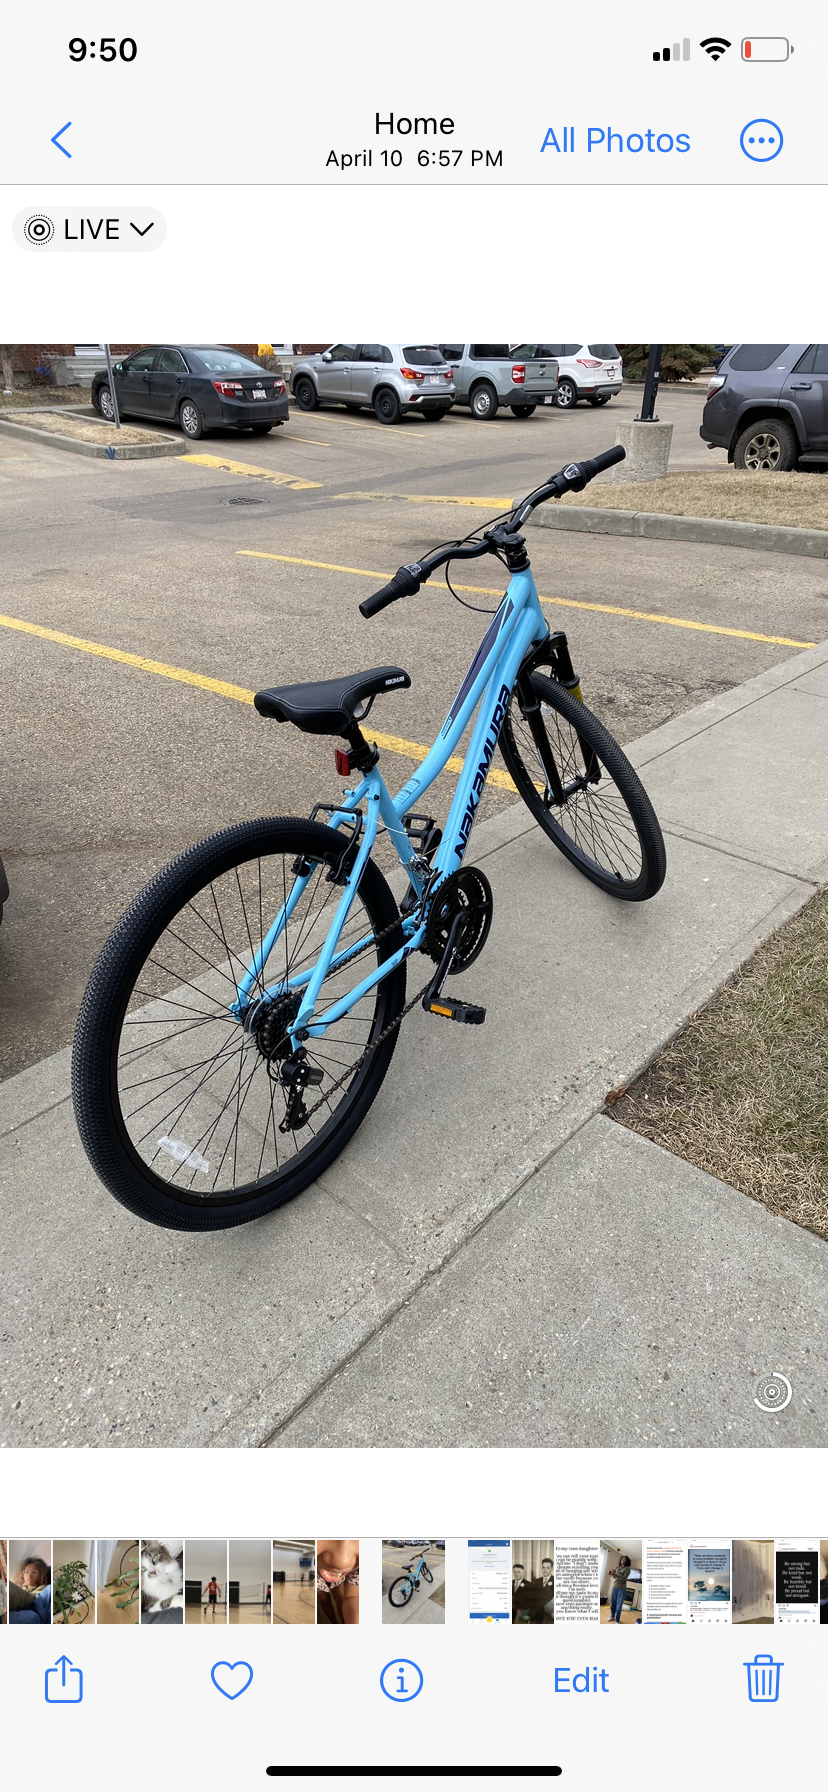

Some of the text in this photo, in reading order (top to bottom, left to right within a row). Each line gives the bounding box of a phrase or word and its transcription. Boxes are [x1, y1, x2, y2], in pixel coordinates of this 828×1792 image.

[69, 38, 137, 62] 9:50
[376, 113, 454, 135] Home
[540, 127, 690, 153] All Photos
[326, 149, 502, 170] April 10 6:57 PM
[65, 219, 119, 239] LIVE
[555, 1667, 609, 1693] Edit
